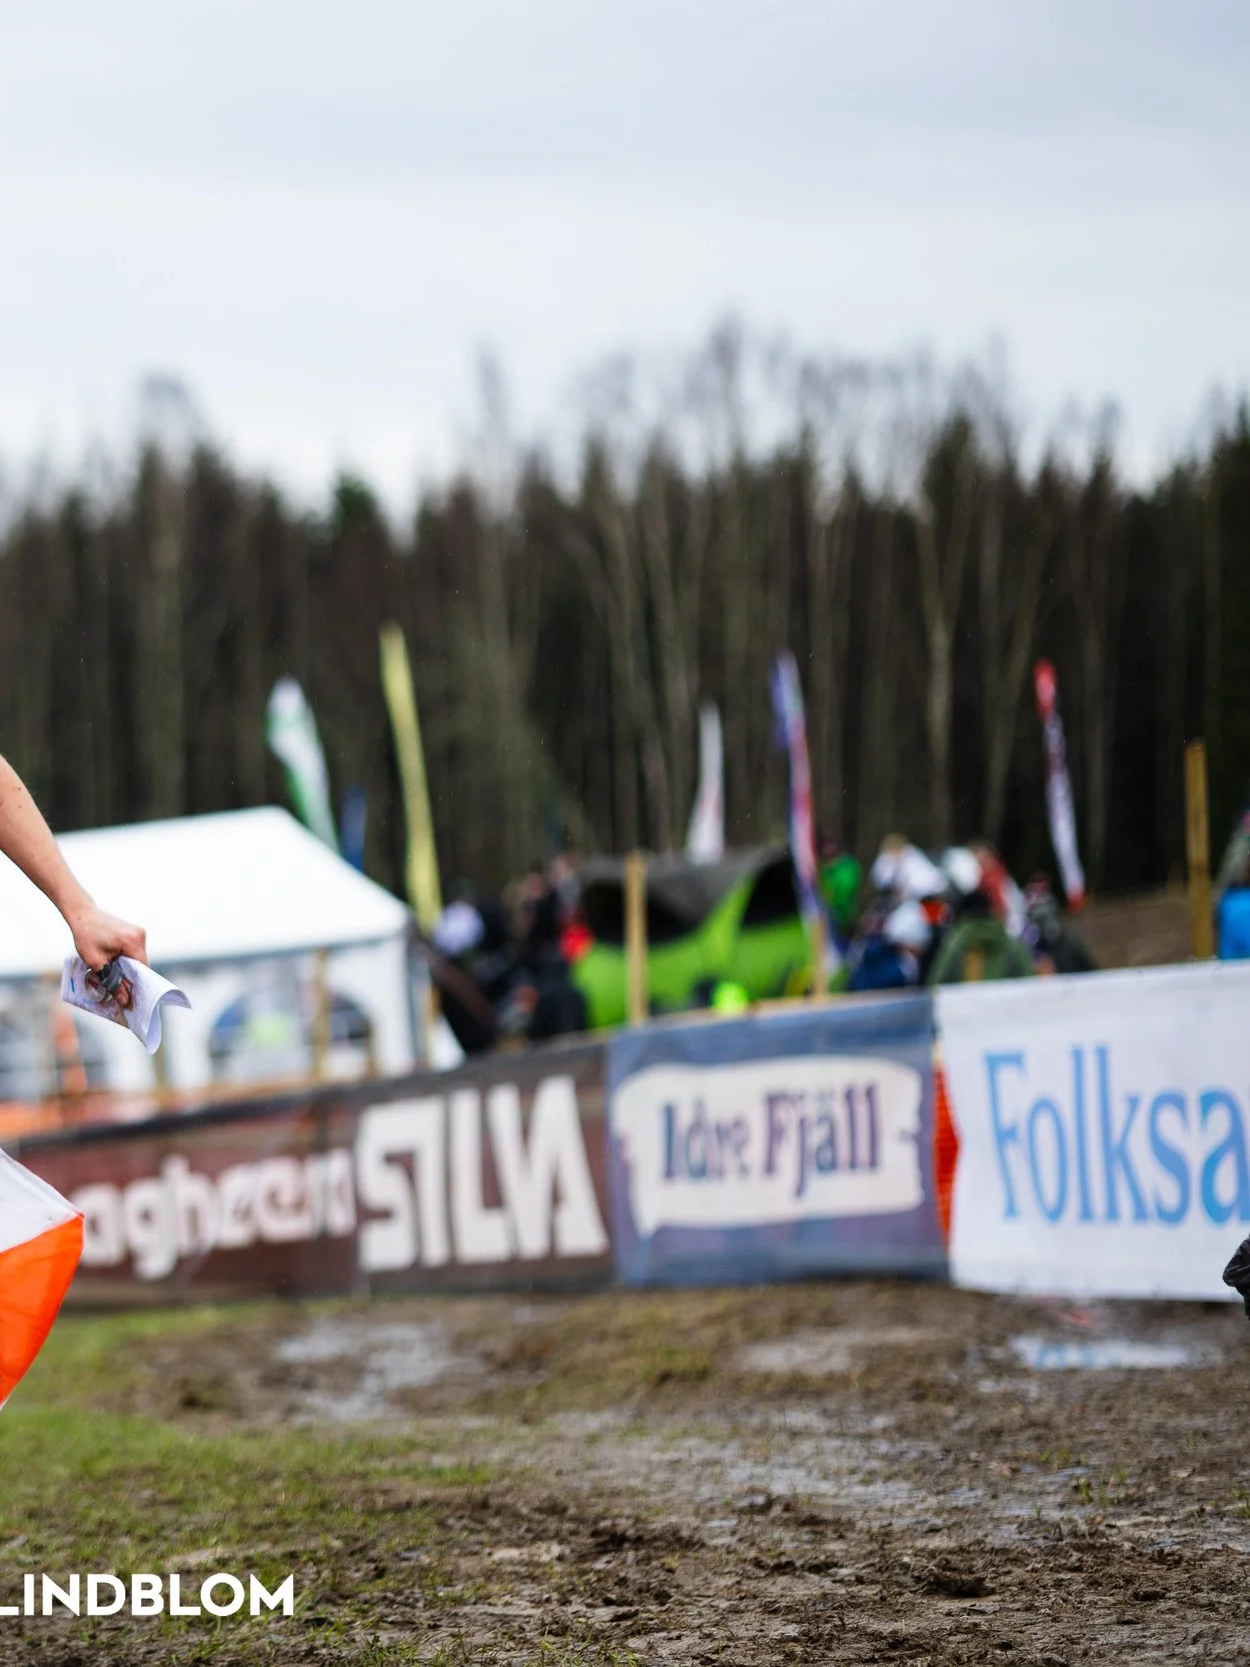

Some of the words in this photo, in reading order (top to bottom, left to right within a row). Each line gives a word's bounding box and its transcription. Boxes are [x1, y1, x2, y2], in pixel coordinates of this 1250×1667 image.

[357, 1074, 608, 1273] SILVA
[661, 1100, 752, 1184] Idre
[761, 1082, 882, 1199] Fjäll
